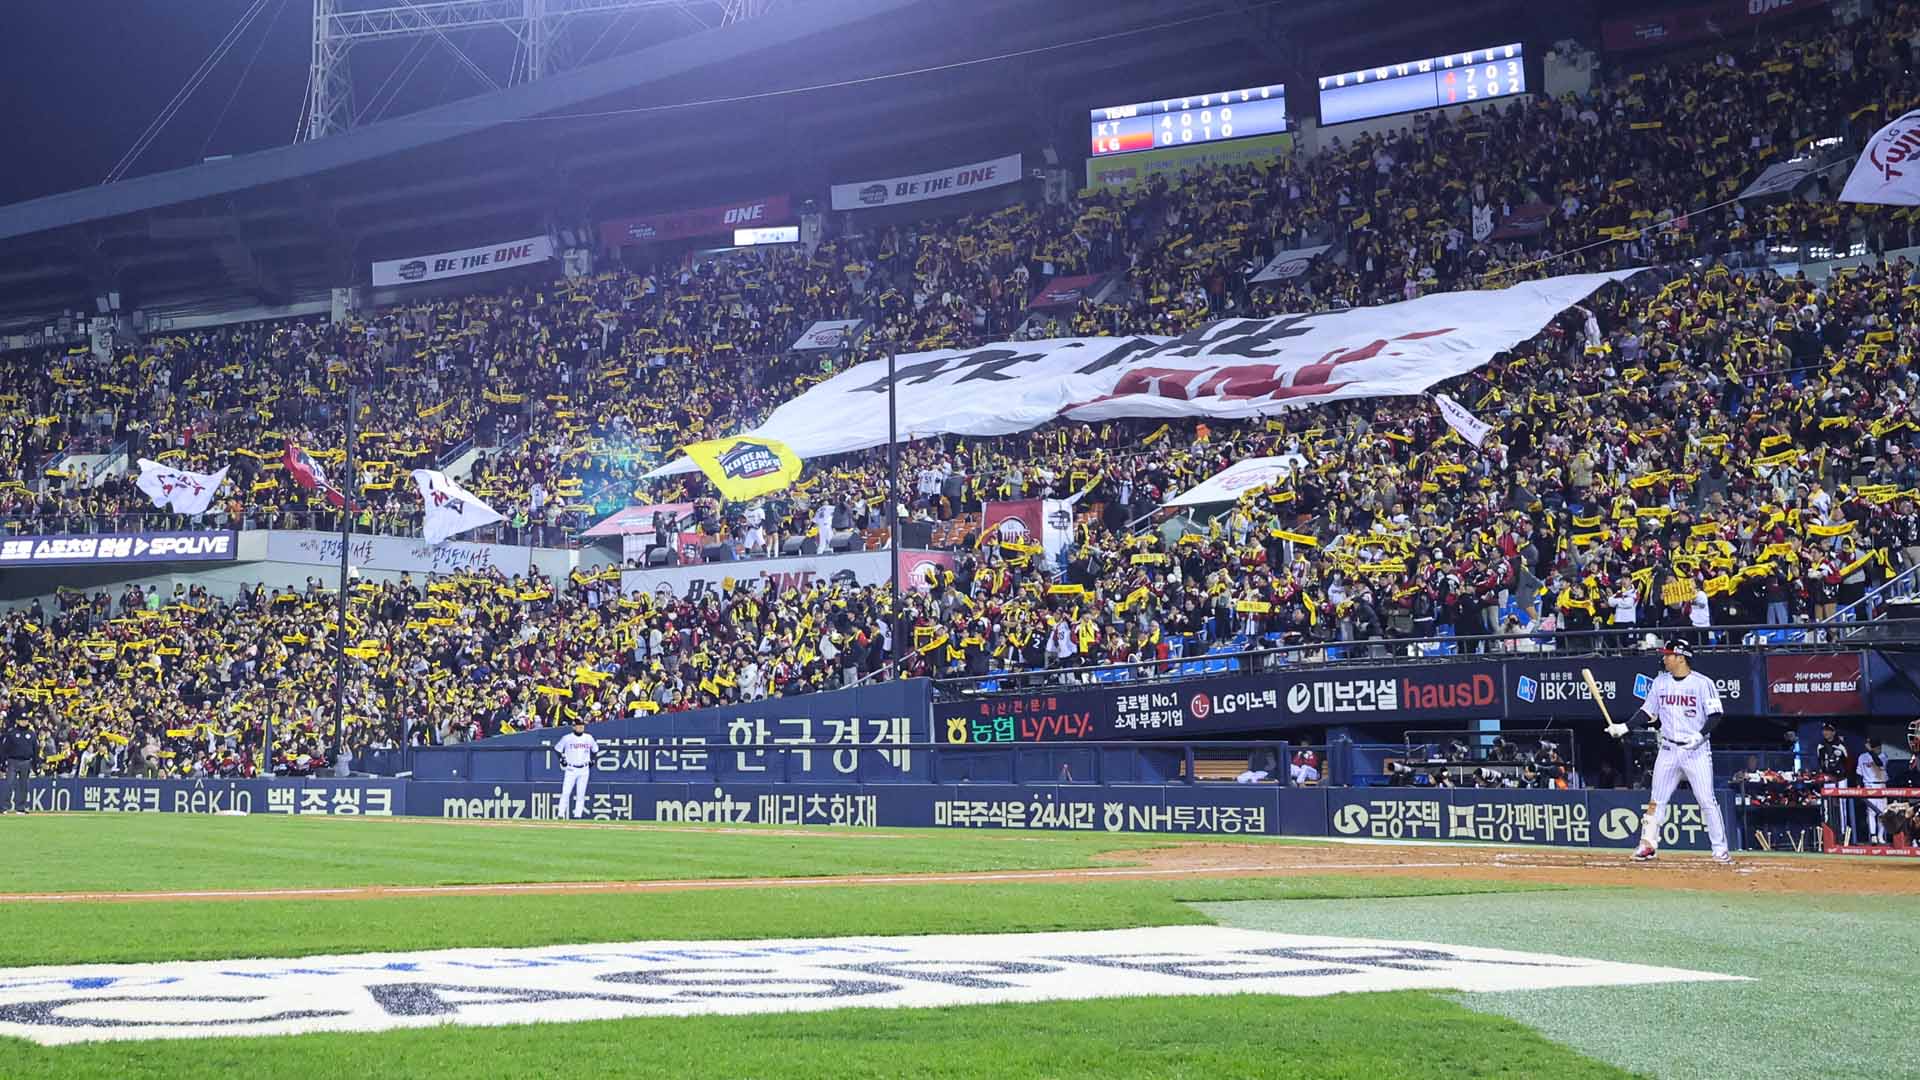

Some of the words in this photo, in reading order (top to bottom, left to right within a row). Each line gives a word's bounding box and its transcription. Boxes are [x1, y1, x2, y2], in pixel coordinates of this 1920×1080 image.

[1376, 69, 1388, 79] 10
[1397, 64, 1408, 76] 11
[1466, 69, 1475, 82] 7
[1486, 65, 1497, 79] 0
[1507, 62, 1517, 75] 3
[1467, 86, 1477, 99] 5
[1488, 82, 1499, 95] 0
[1509, 78, 1519, 92] 2
[1161, 115, 1172, 129] 4
[1181, 113, 1192, 127] 0
[1201, 110, 1212, 124] 0
[1221, 108, 1232, 121] 0
[1098, 137, 1120, 152] LG
[1162, 131, 1173, 145] 0
[1181, 128, 1193, 142] 0
[1203, 127, 1210, 140] 1
[1221, 123, 1232, 137] 0
[1885, 128, 1899, 143] LG
[895, 182, 919, 196] BE
[923, 175, 953, 193] THE
[956, 164, 998, 186] ONE
[723, 204, 765, 224] ONE
[433, 258, 457, 272] BE
[461, 252, 491, 270] THE
[494, 243, 535, 262] ONE
[724, 450, 769, 473] KOREAN
[744, 459, 779, 472] SERIES
[148, 535, 230, 555] SPOLIVE
[1117, 694, 1150, 711] 글로벌
[1152, 693, 1178, 707] No.1
[1213, 690, 1277, 714] LG이노텍
[1314, 679, 1397, 713] 대보건설
[1403, 674, 1494, 708] hausD
[1660, 695, 1697, 707] TWINS
[972, 717, 1015, 744] 농협
[728, 718, 911, 773] 한국경제
[84, 786, 160, 813] 백조씽크
[266, 788, 393, 816] 백조씽크
[444, 786, 525, 820] meritz
[656, 788, 751, 823] meritz
[758, 794, 877, 827] 메리츠화재
[935, 801, 1025, 827] 미국주식은
[1029, 795, 1094, 829] 24시간
[1129, 805, 1265, 833] NH투자증권
[1370, 801, 1440, 838] 금강주택
[1476, 803, 1590, 842] 금강펜테리움
[0, 945, 1588, 1028] CASPER
